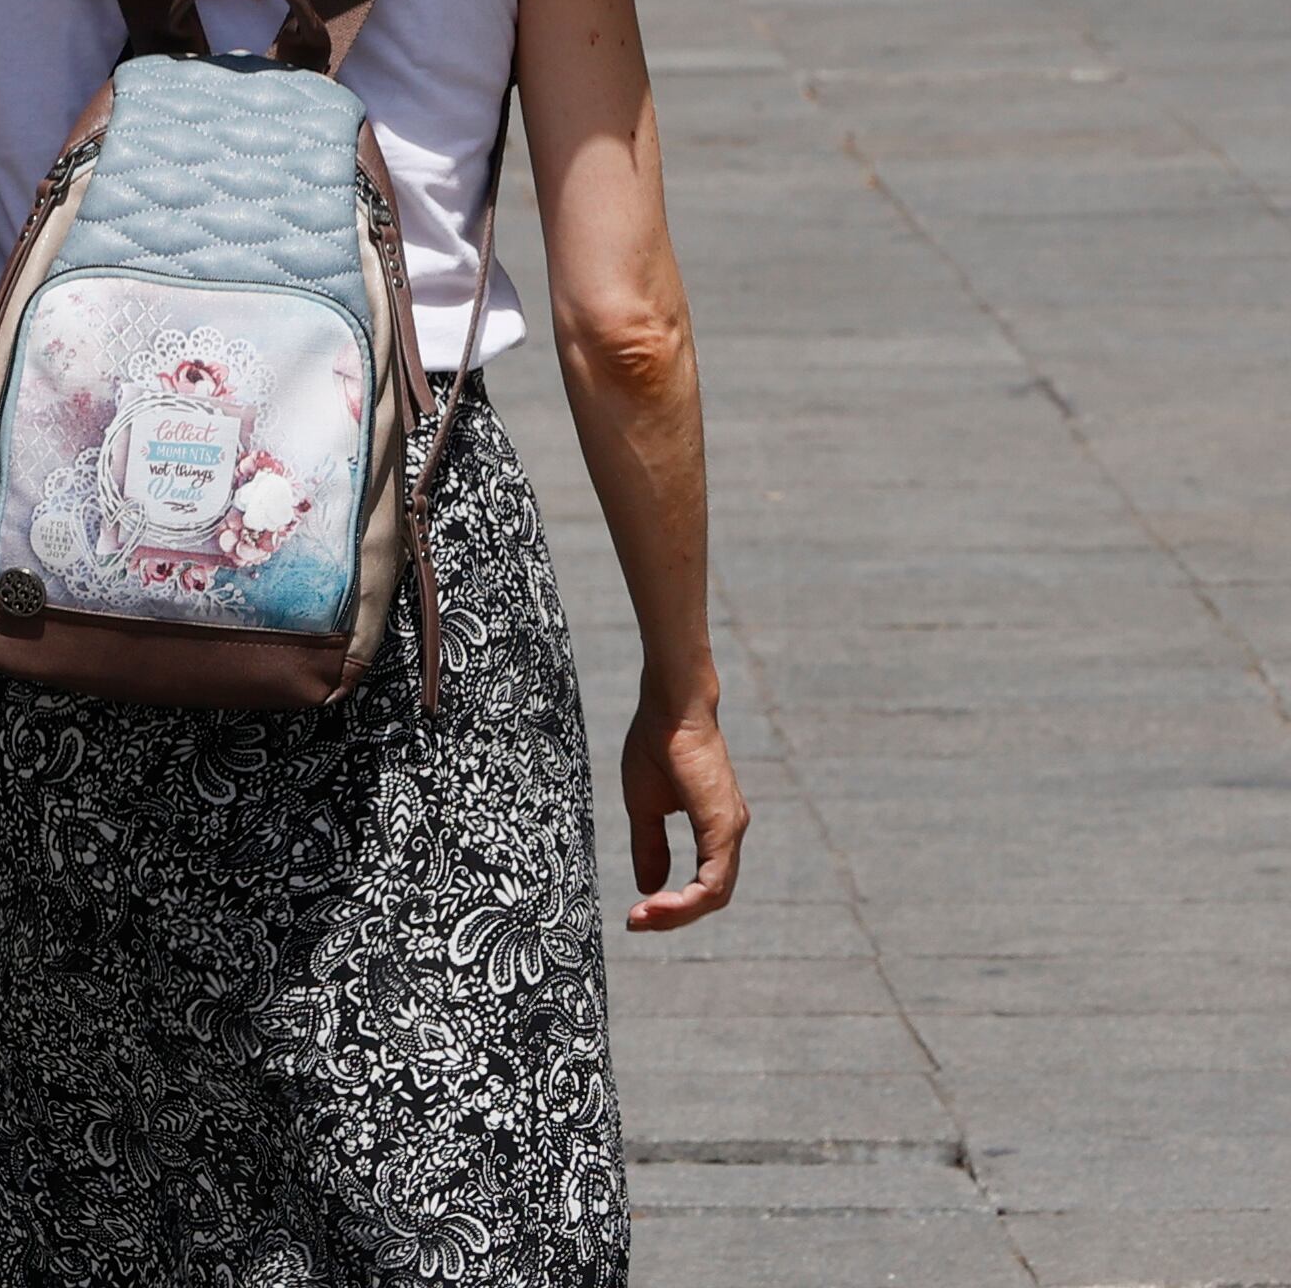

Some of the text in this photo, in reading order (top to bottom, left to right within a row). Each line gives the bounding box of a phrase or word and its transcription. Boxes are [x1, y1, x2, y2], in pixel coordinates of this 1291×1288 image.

[153, 419, 219, 443] Collect
[149, 462, 216, 489] not things
